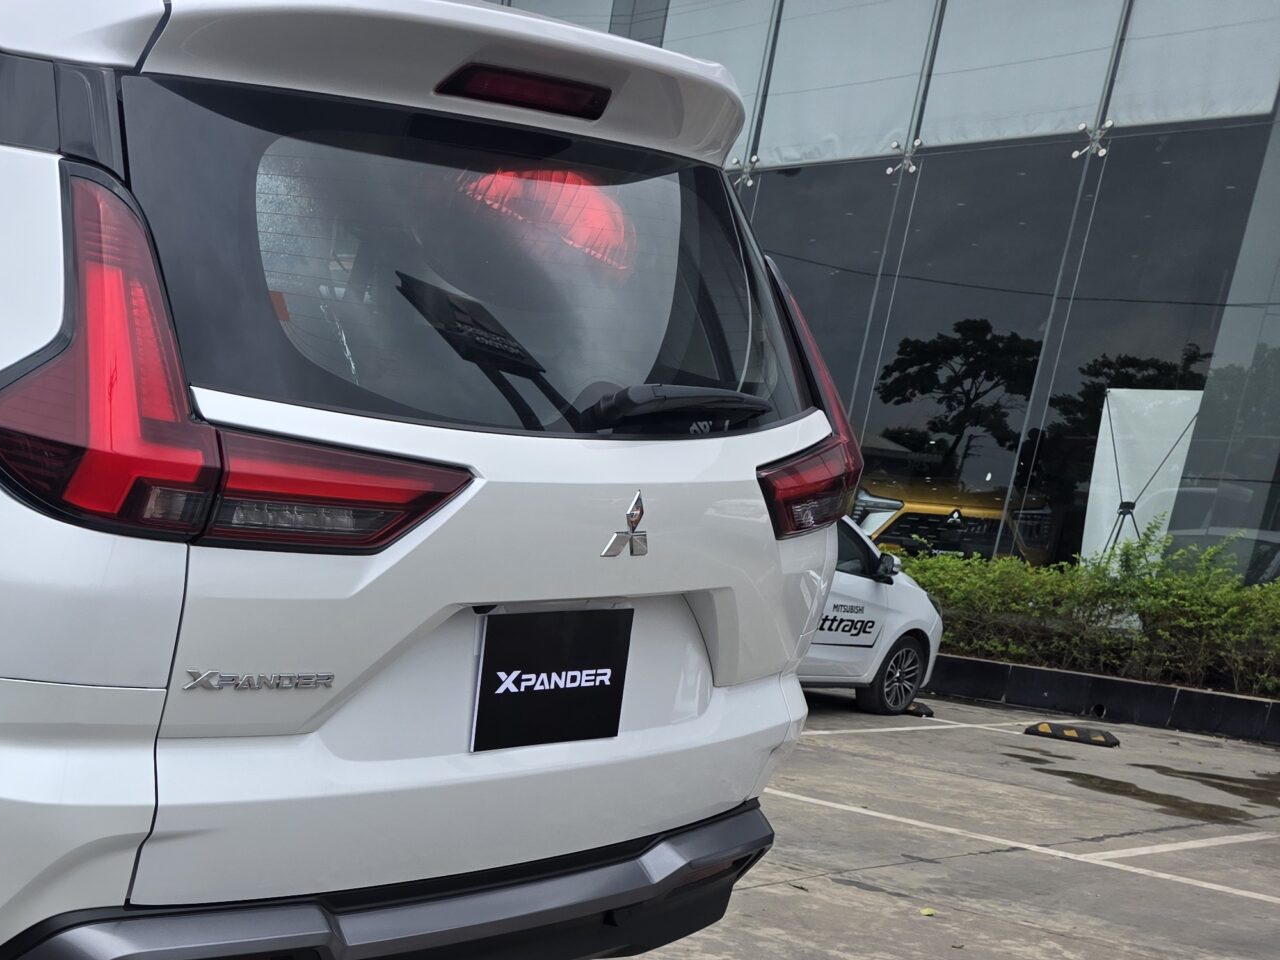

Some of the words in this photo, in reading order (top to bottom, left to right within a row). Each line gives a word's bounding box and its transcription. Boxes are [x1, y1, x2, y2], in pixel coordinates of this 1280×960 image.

[832, 603, 865, 615] MITSUBISHI
[817, 614, 876, 637] ttrage
[182, 669, 335, 691] XPANDER
[495, 668, 612, 694] XPANDER
